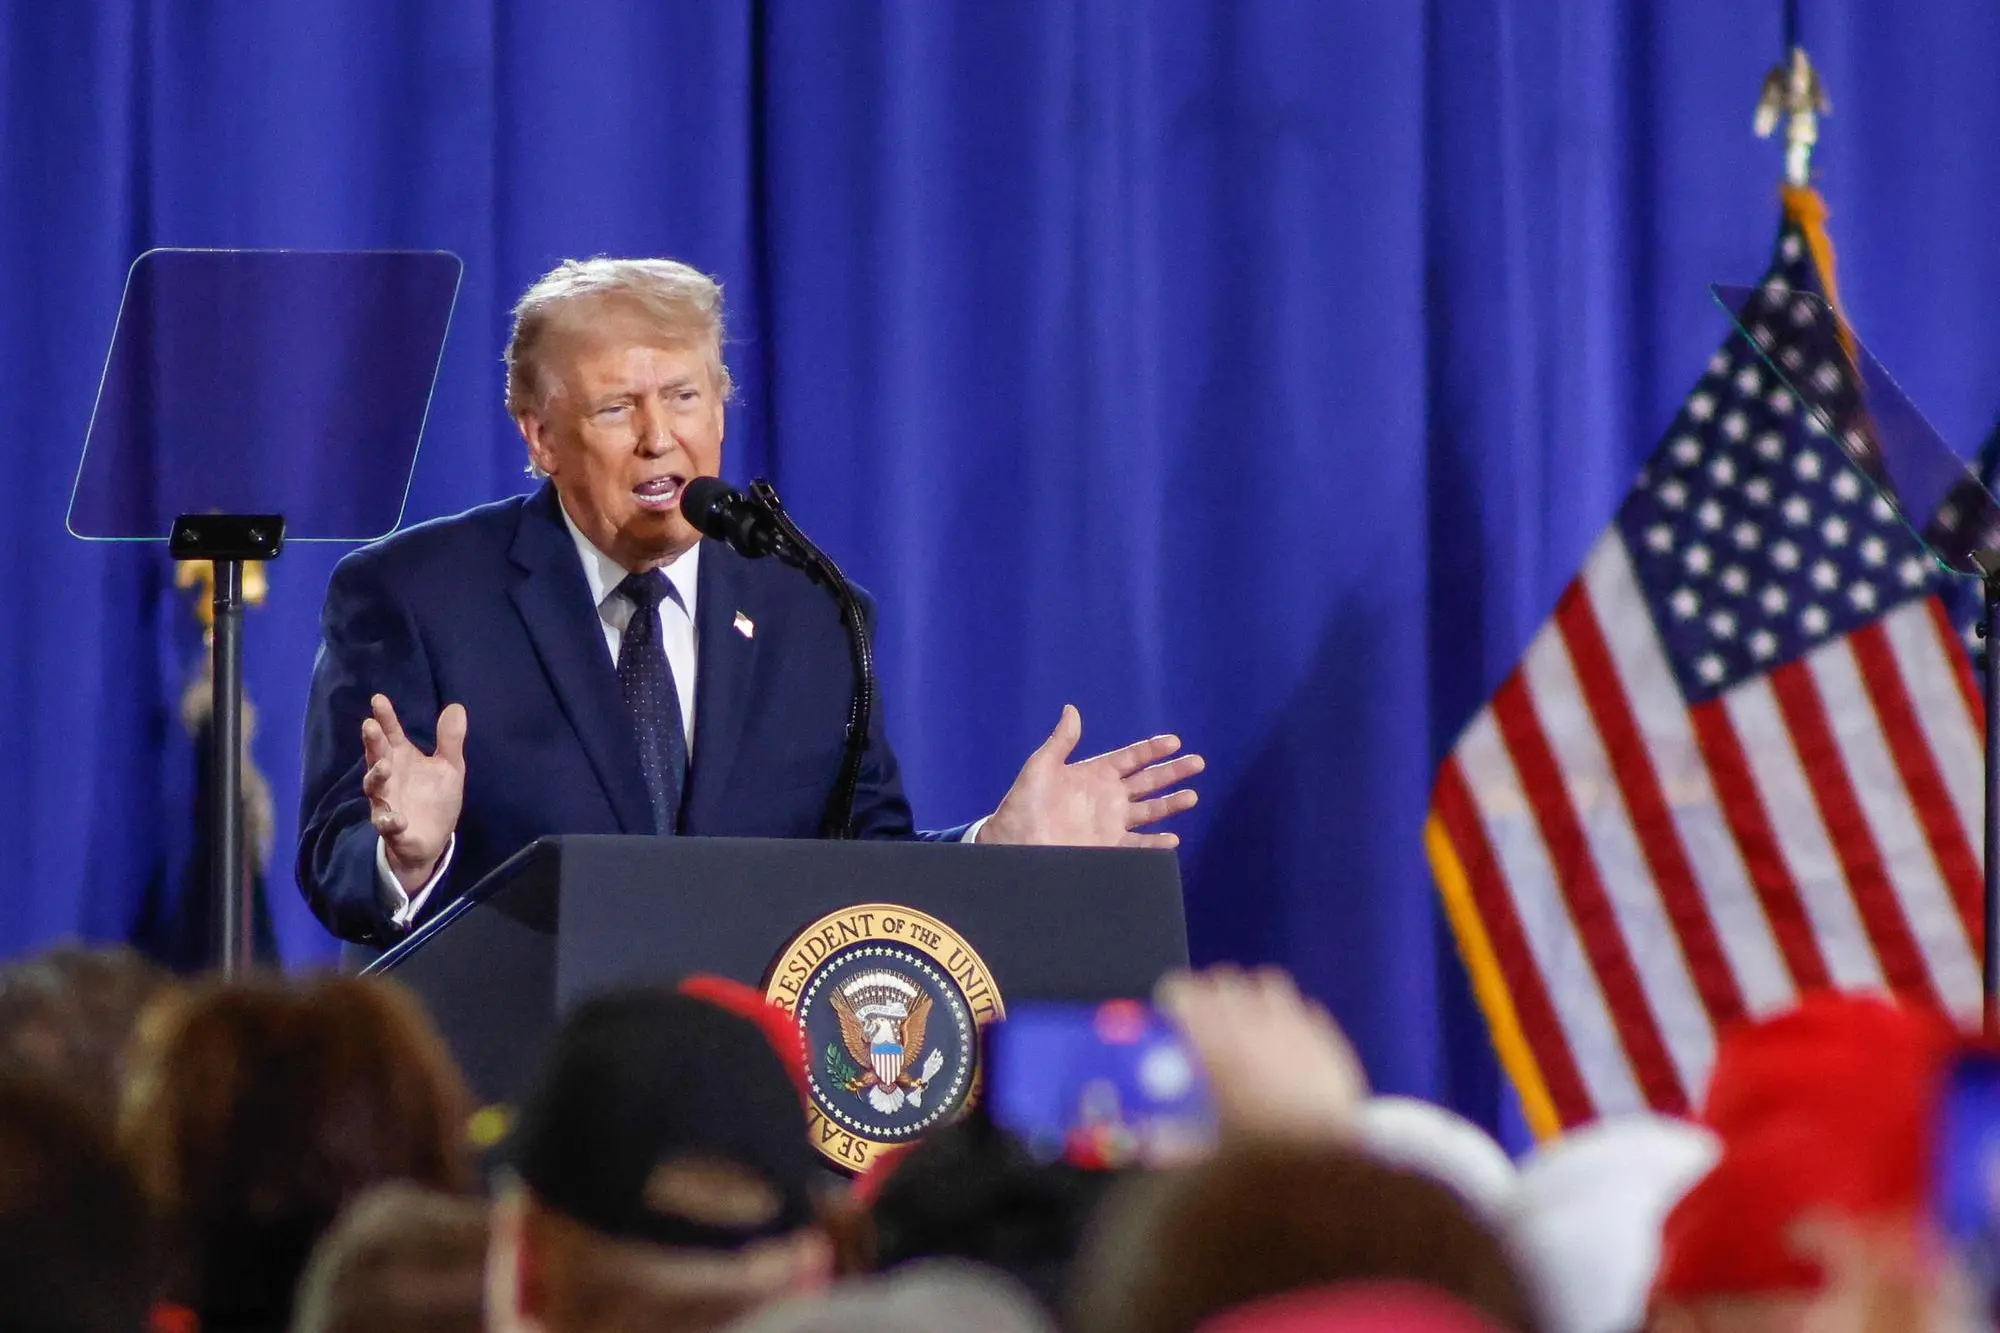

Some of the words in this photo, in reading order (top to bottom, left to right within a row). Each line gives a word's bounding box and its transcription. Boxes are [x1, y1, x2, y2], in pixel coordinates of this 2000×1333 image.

[774, 913, 874, 1013] RESIDENT
[882, 917, 905, 934] OF
[910, 922, 941, 950] THE
[947, 947, 997, 1019] UNIT
[807, 1106, 868, 1163] SEAL
